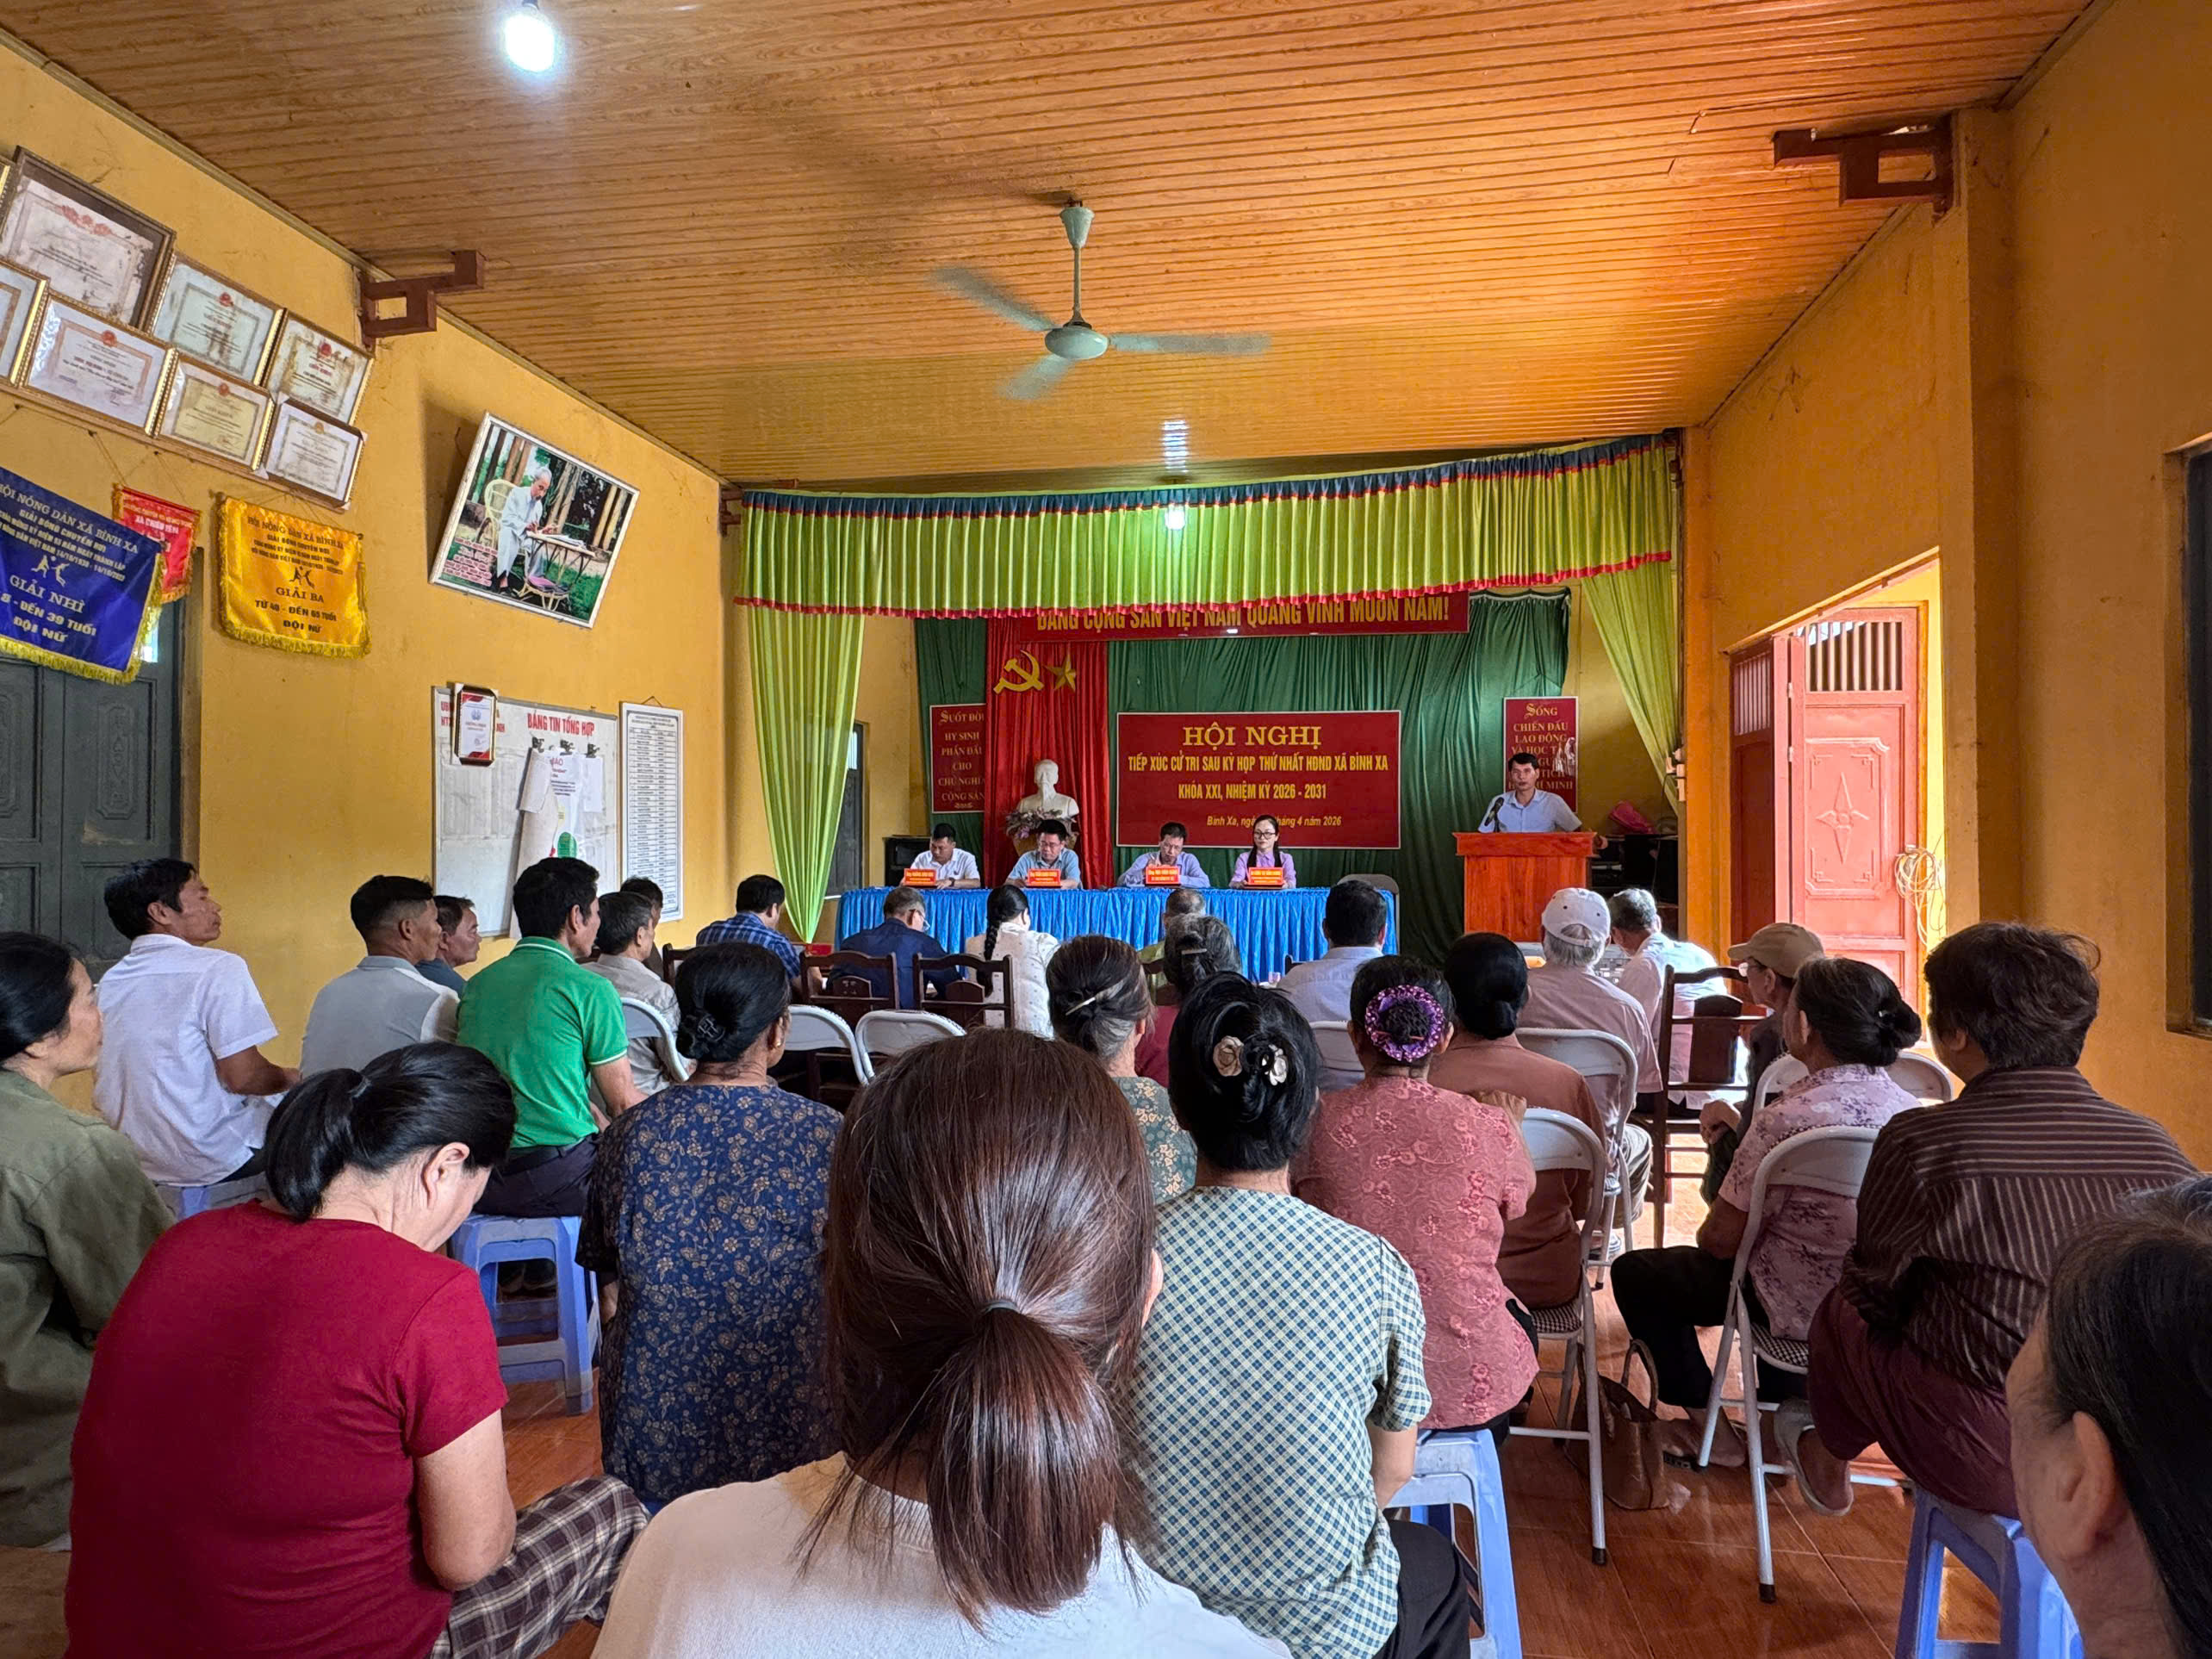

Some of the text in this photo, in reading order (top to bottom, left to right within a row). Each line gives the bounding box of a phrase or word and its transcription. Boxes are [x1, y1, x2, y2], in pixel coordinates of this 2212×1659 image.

[9, 575, 85, 613] GIẢI NHÌ
[276, 586, 324, 603] GIẢI BA
[20, 600, 45, 618] ĐẾN
[47, 612, 65, 625] 39
[67, 618, 96, 636] TUỔI
[289, 606, 308, 616] ĐẾN
[1205, 606, 1241, 627] NAM
[1246, 604, 1302, 628] QUANG
[1306, 600, 1345, 624] VINH
[13, 616, 68, 643] ĐỘI NỮ
[283, 619, 304, 630] ĐỘI
[549, 717, 561, 732] TIN
[562, 716, 580, 735] TỔNG
[581, 722, 595, 736] HỢP
[1513, 719, 1568, 732] CHIẾN ĐẤU
[1183, 721, 1321, 751] HỘI NGHỊ
[1515, 734, 1536, 743] LAO
[1128, 752, 1147, 772] TIẾP
[1150, 752, 1168, 772] XÚC
[1171, 749, 1184, 772] CỬ
[1185, 755, 1200, 772] TRI
[1202, 755, 1220, 772] SAU
[1237, 755, 1256, 774] HỌP
[1259, 751, 1278, 772] THỨ
[1279, 751, 1303, 772] NHẤT
[1306, 755, 1332, 772] HĐND
[1335, 752, 1347, 771] XÃ
[1350, 752, 1372, 771] BÌNH
[1375, 755, 1389, 771] XA
[1178, 780, 1202, 799] KHÓA
[1206, 783, 1223, 801] XXI,
[1226, 780, 1256, 801] NHIỆM
[1273, 783, 1296, 799] 2026
[1304, 783, 1327, 799] 2031
[1297, 816, 1302, 826] 4
[1304, 816, 1321, 826] năm
[1323, 816, 1342, 826] 2026
